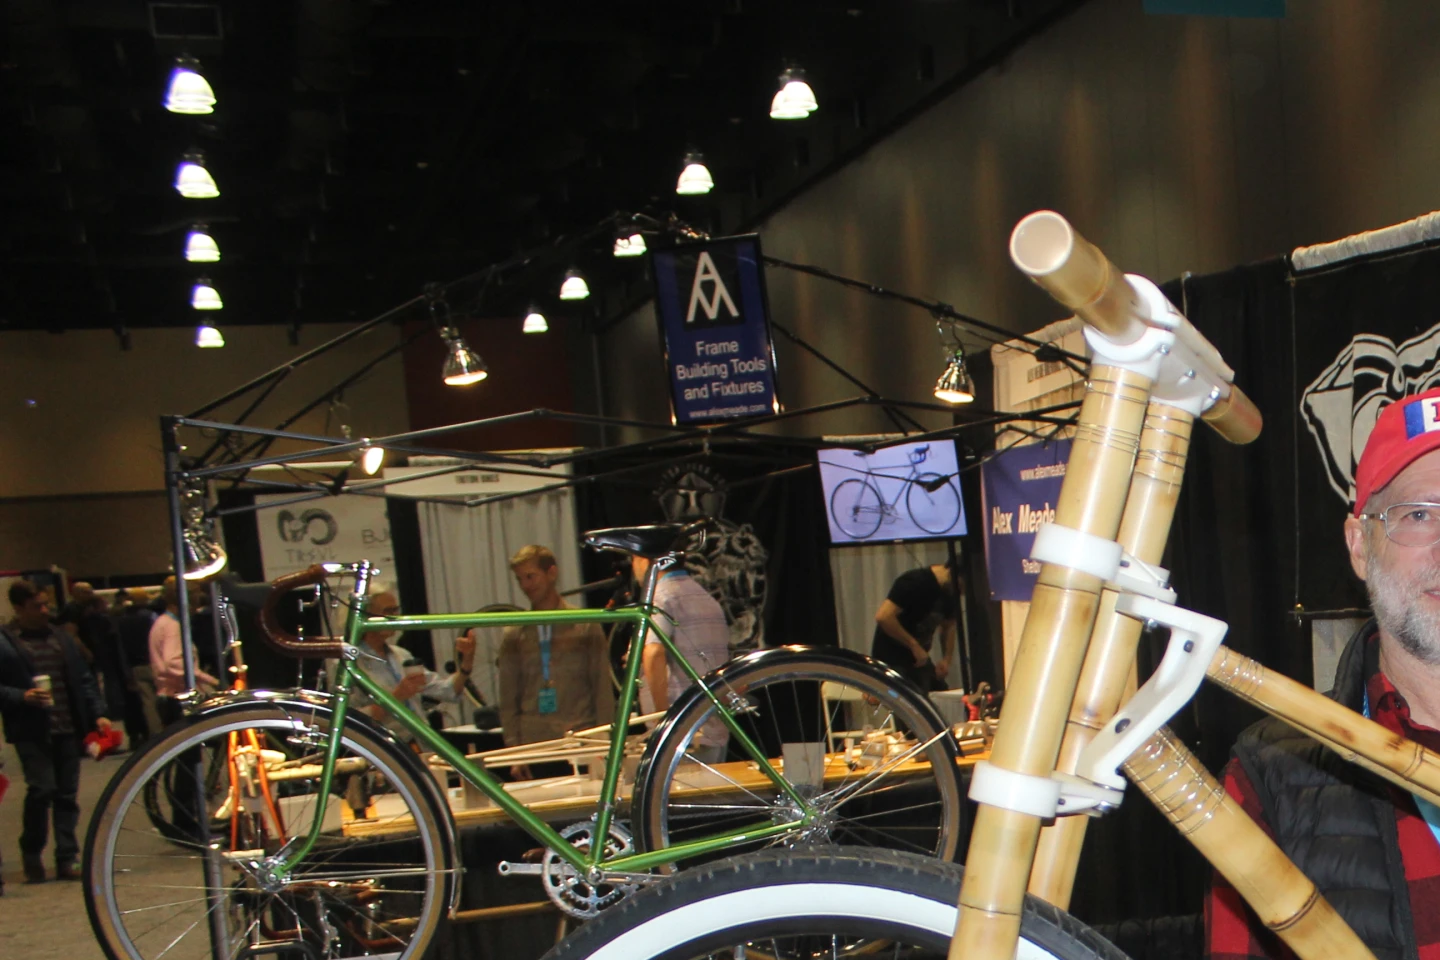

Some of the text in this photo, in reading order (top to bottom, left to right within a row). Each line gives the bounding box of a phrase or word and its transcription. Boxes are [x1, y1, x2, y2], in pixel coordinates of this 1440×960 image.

[695, 340, 739, 357] Frame
[676, 357, 767, 380] Building Tools
[684, 380, 765, 401] and Fixtures
[1020, 461, 1068, 481] www.alexmeade
[992, 506, 1012, 535] Alex
[1018, 502, 1055, 533] Meade
